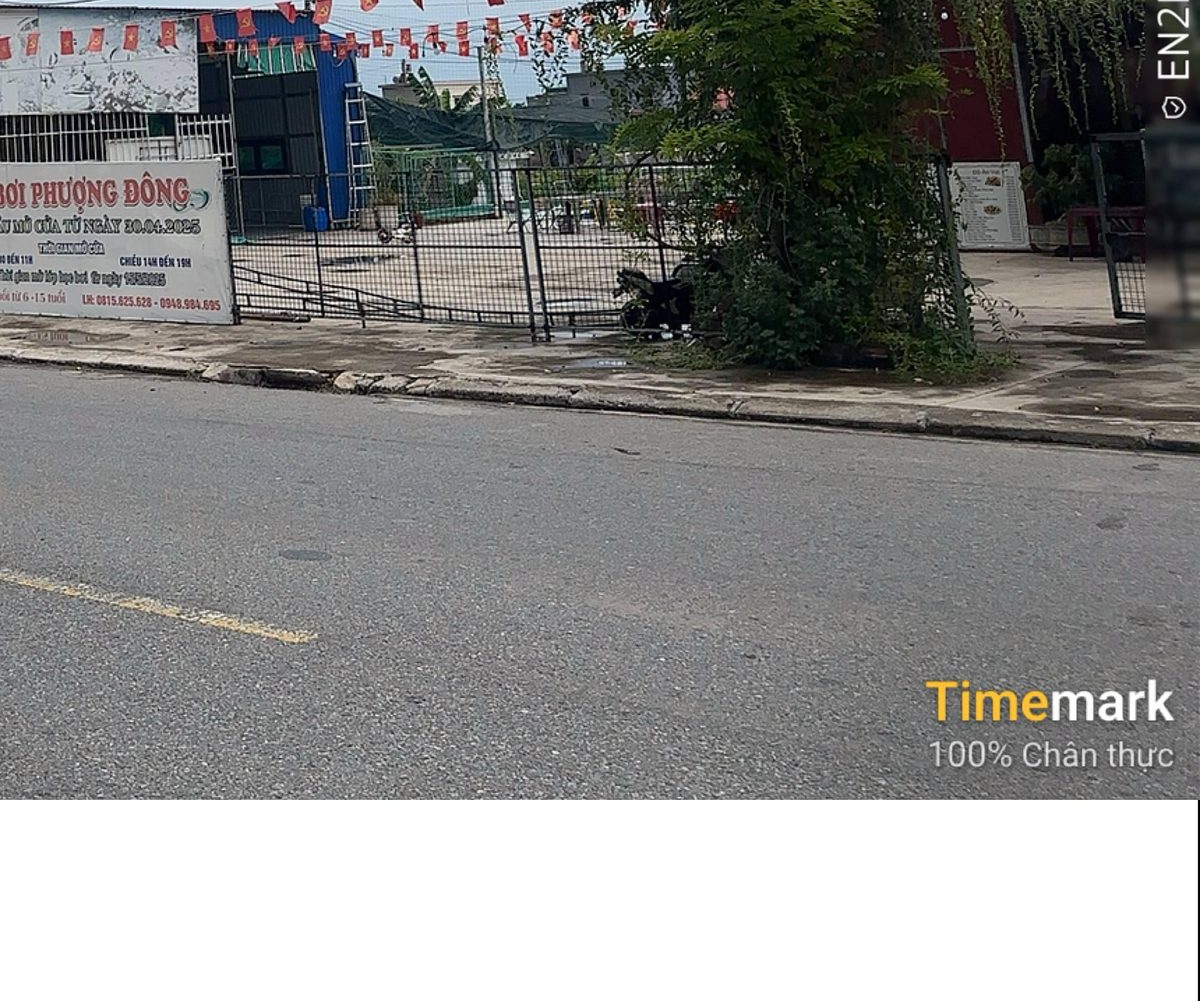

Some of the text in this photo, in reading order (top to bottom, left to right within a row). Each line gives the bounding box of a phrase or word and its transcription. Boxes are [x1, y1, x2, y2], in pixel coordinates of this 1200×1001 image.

[31, 176, 118, 214] PHƯỢNG
[123, 171, 190, 207] ĐÔNG
[34, 214, 61, 234] CỬA
[63, 214, 81, 234] TỪ
[83, 214, 122, 234] NGÀY
[124, 219, 201, 235] 30.04.2025
[143, 257, 158, 267] 14H
[176, 257, 191, 268] 19H
[23, 293, 29, 302] 6
[48, 290, 66, 304] tuổi
